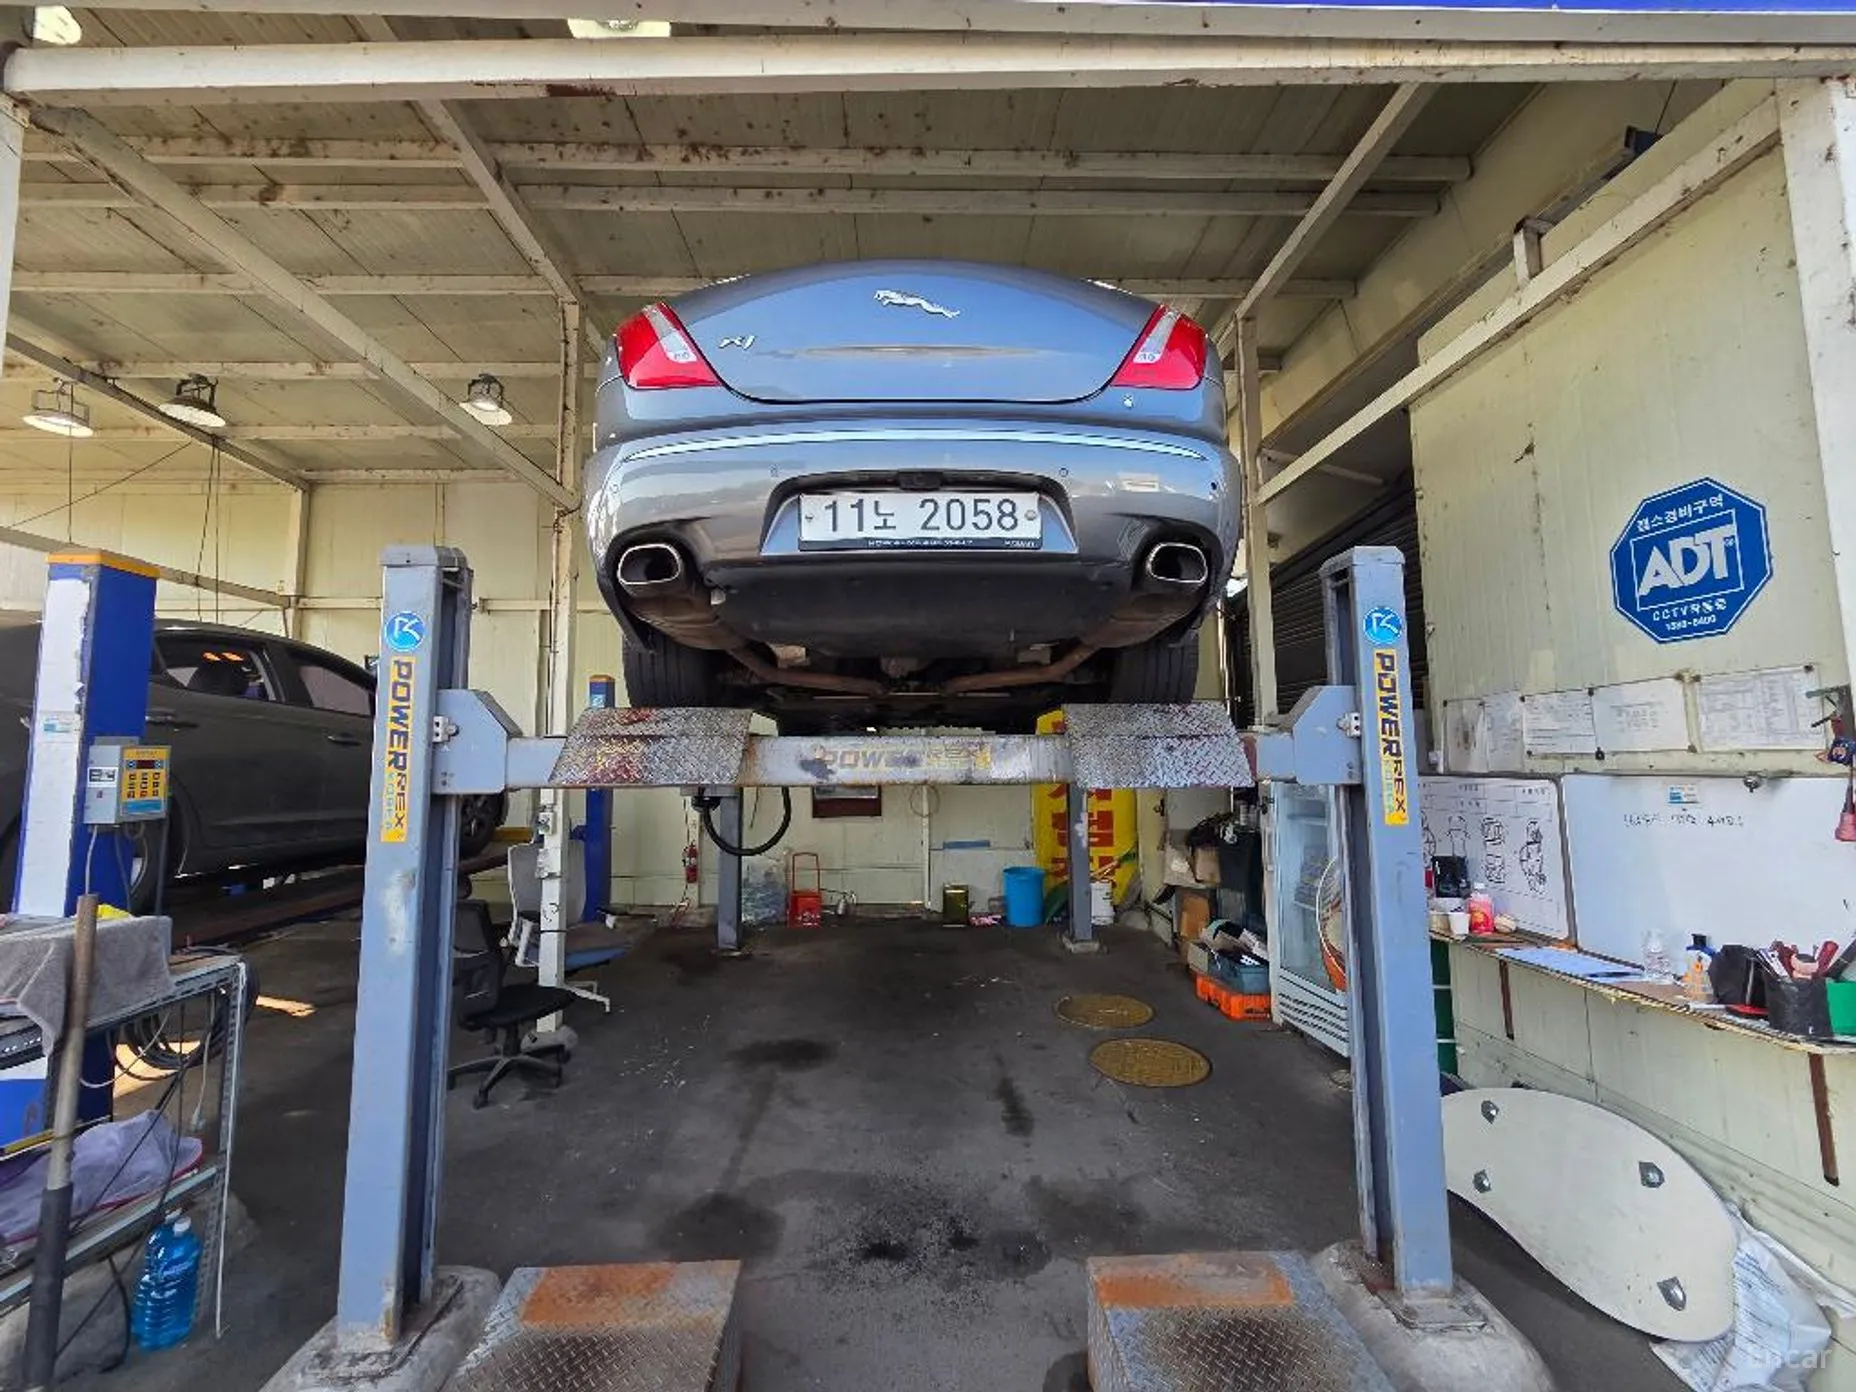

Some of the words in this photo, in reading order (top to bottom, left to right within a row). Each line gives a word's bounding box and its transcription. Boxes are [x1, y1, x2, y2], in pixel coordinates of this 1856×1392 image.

[824, 498, 897, 533] 11노
[918, 498, 1019, 532] 2058
[1638, 523, 1738, 596] ADT
